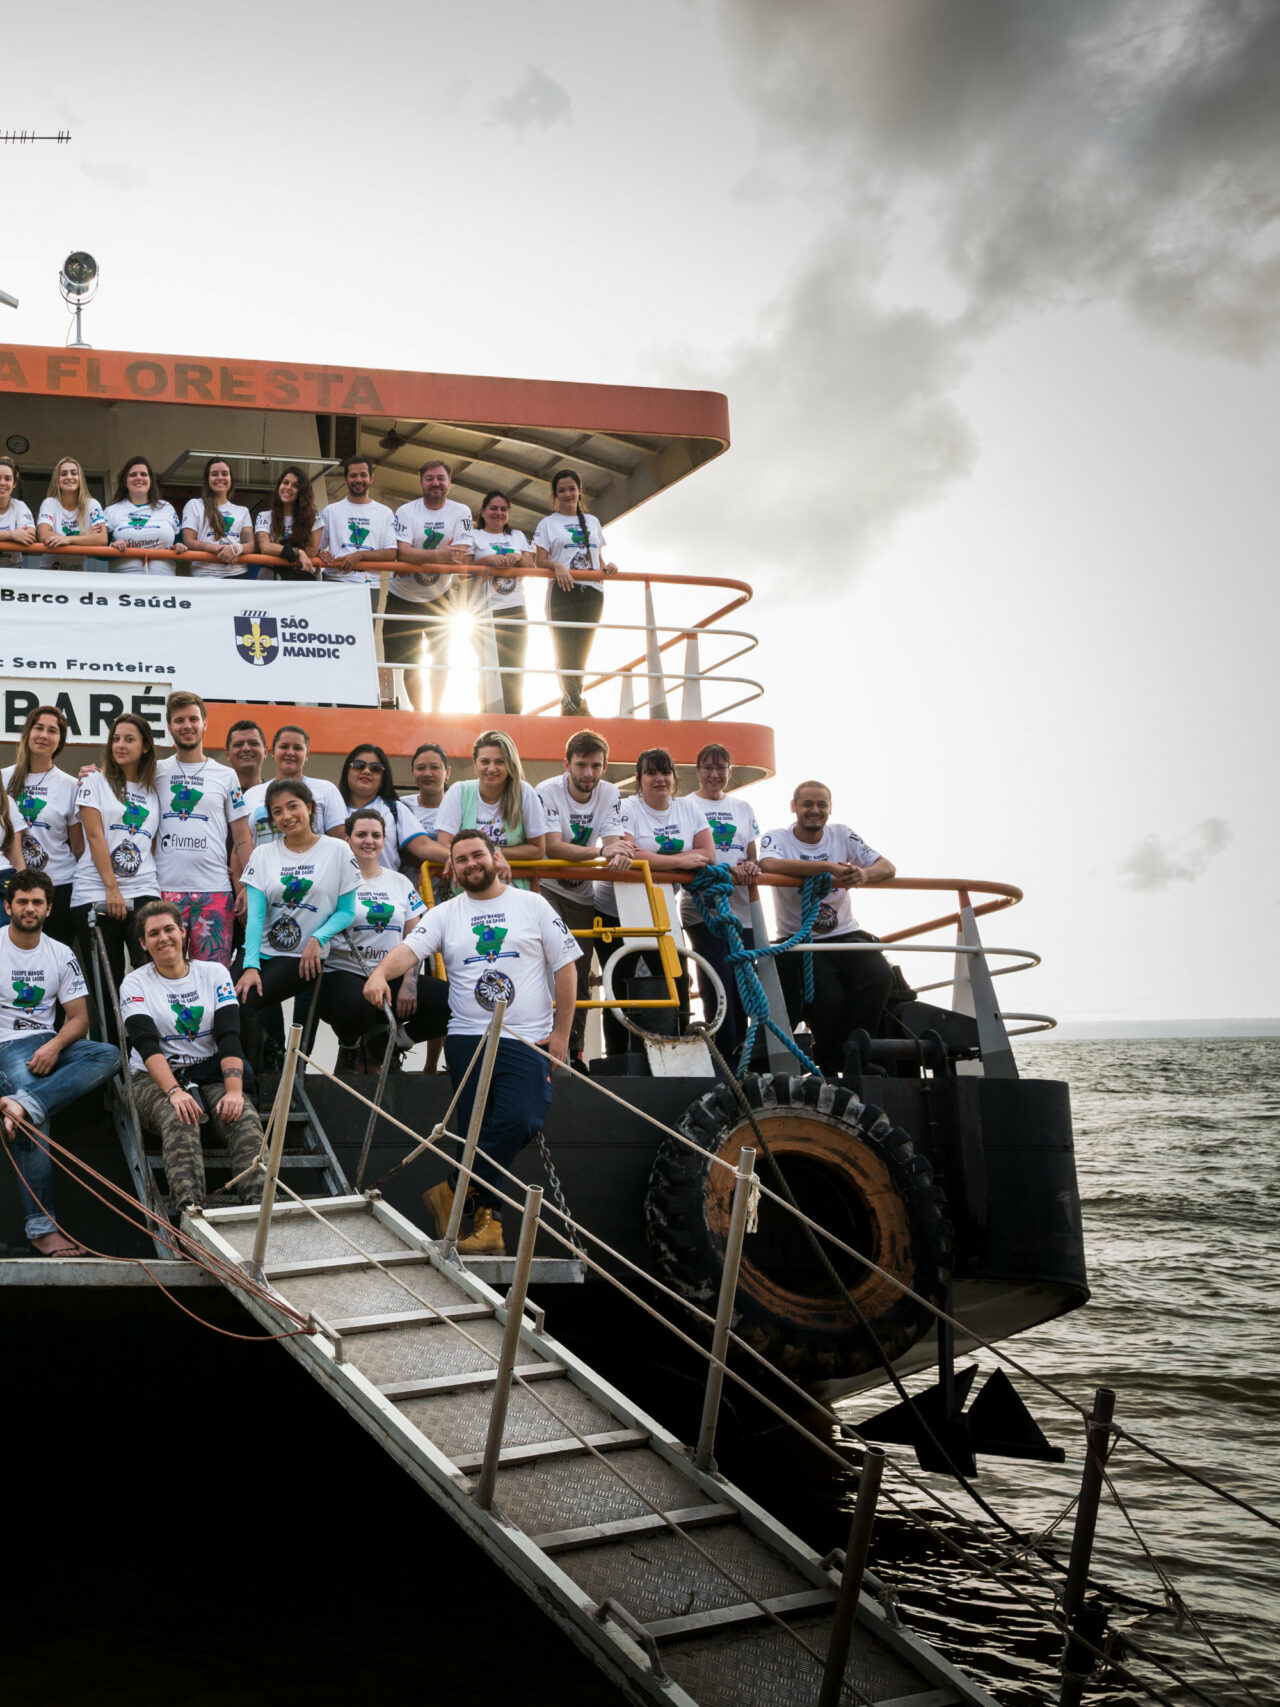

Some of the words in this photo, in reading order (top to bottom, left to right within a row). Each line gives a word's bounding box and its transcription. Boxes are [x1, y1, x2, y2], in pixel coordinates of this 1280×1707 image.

[45, 355, 385, 412] FLORESTA
[0, 586, 70, 605] Barco
[79, 592, 109, 606] da
[118, 594, 192, 610] Saúde
[280, 615, 310, 630] SÃO
[281, 632, 357, 646] LEOPOLDO
[282, 647, 341, 660] MANDIC
[12, 657, 58, 670] Sem
[66, 659, 177, 674] Fronteiras
